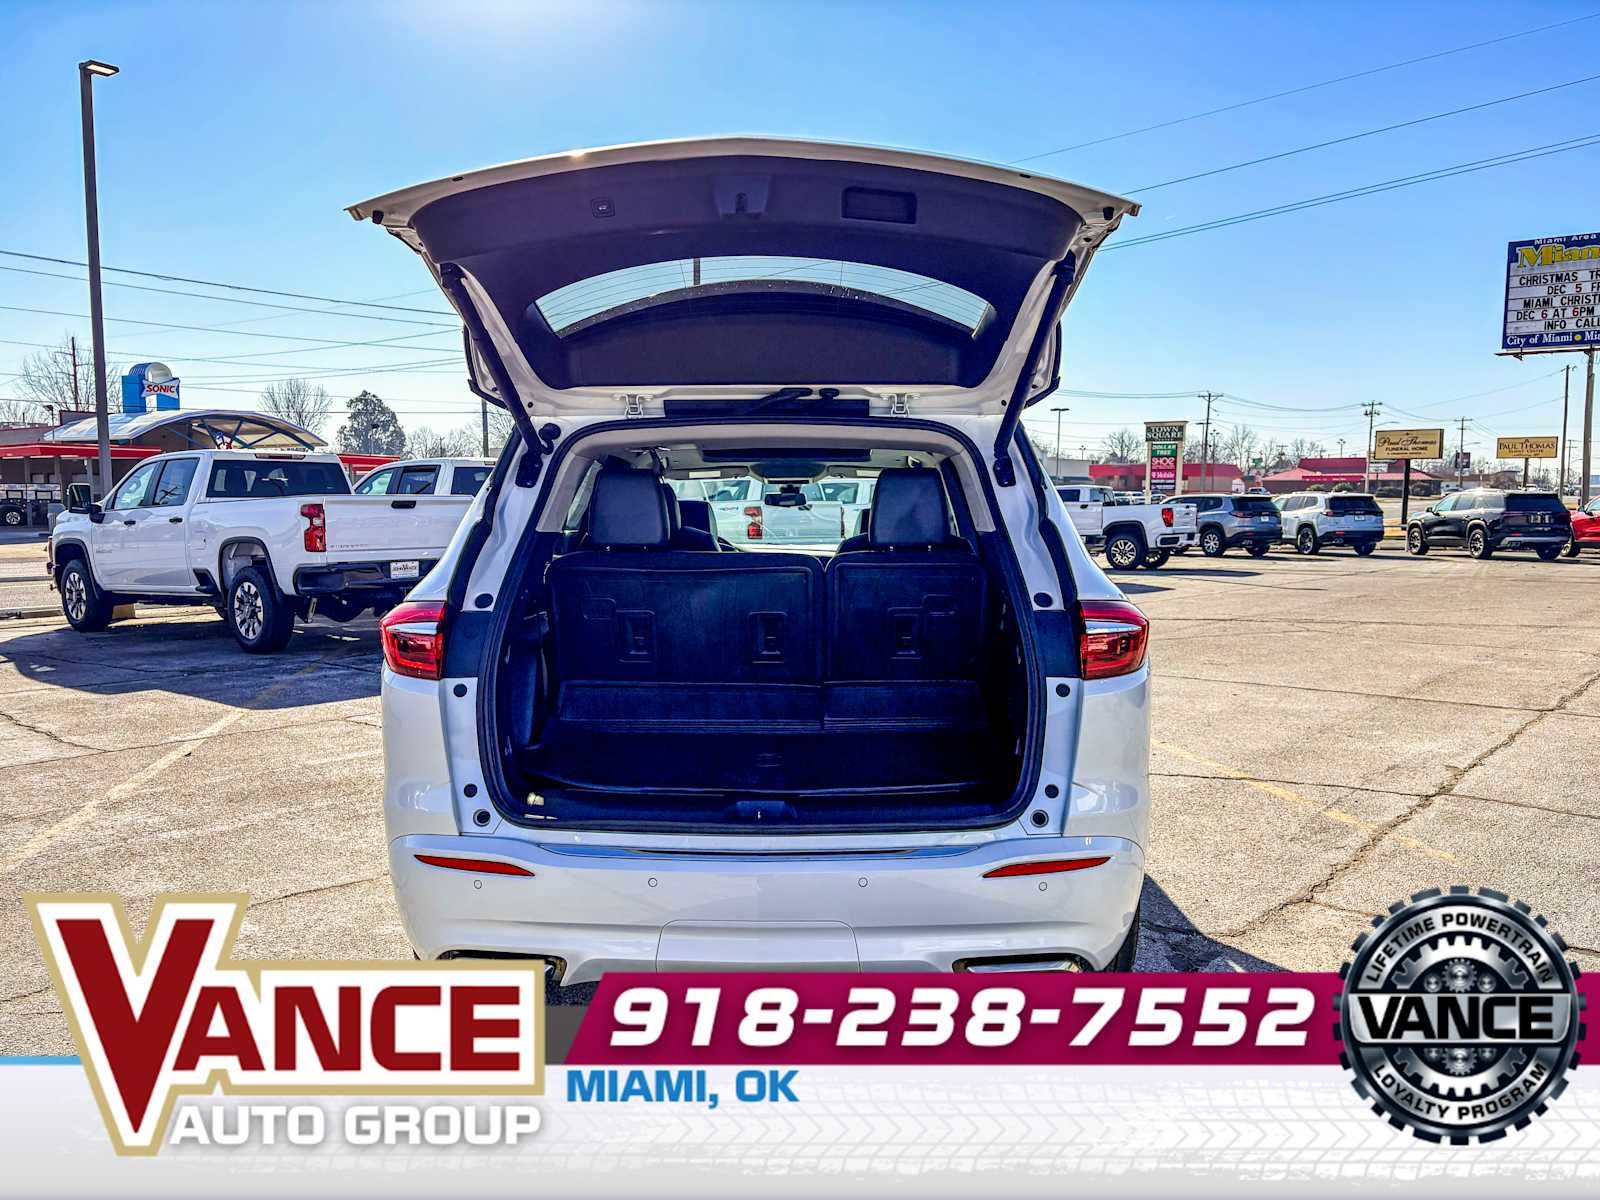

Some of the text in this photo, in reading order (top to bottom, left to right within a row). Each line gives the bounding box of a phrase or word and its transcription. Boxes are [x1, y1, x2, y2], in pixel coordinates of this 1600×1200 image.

[1534, 233, 1598, 246] Miami Area
[1519, 271, 1578, 286] CHRISTMAS
[1547, 285, 1566, 295] DEC
[1575, 283, 1582, 292] 5
[1523, 294, 1600, 309] MIAMI CHRIST
[1516, 306, 1595, 320] DEC 6 AT 6PM
[1544, 319, 1567, 330] INFO
[1507, 335, 1526, 347] City
[1529, 334, 1538, 344] of
[1542, 332, 1573, 343] Miami
[146, 384, 176, 393] SONIC
[1146, 431, 1183, 439] SQUARE
[1377, 436, 1437, 447] Paul Thomas
[1499, 441, 1556, 450] PAUL THOMAS
